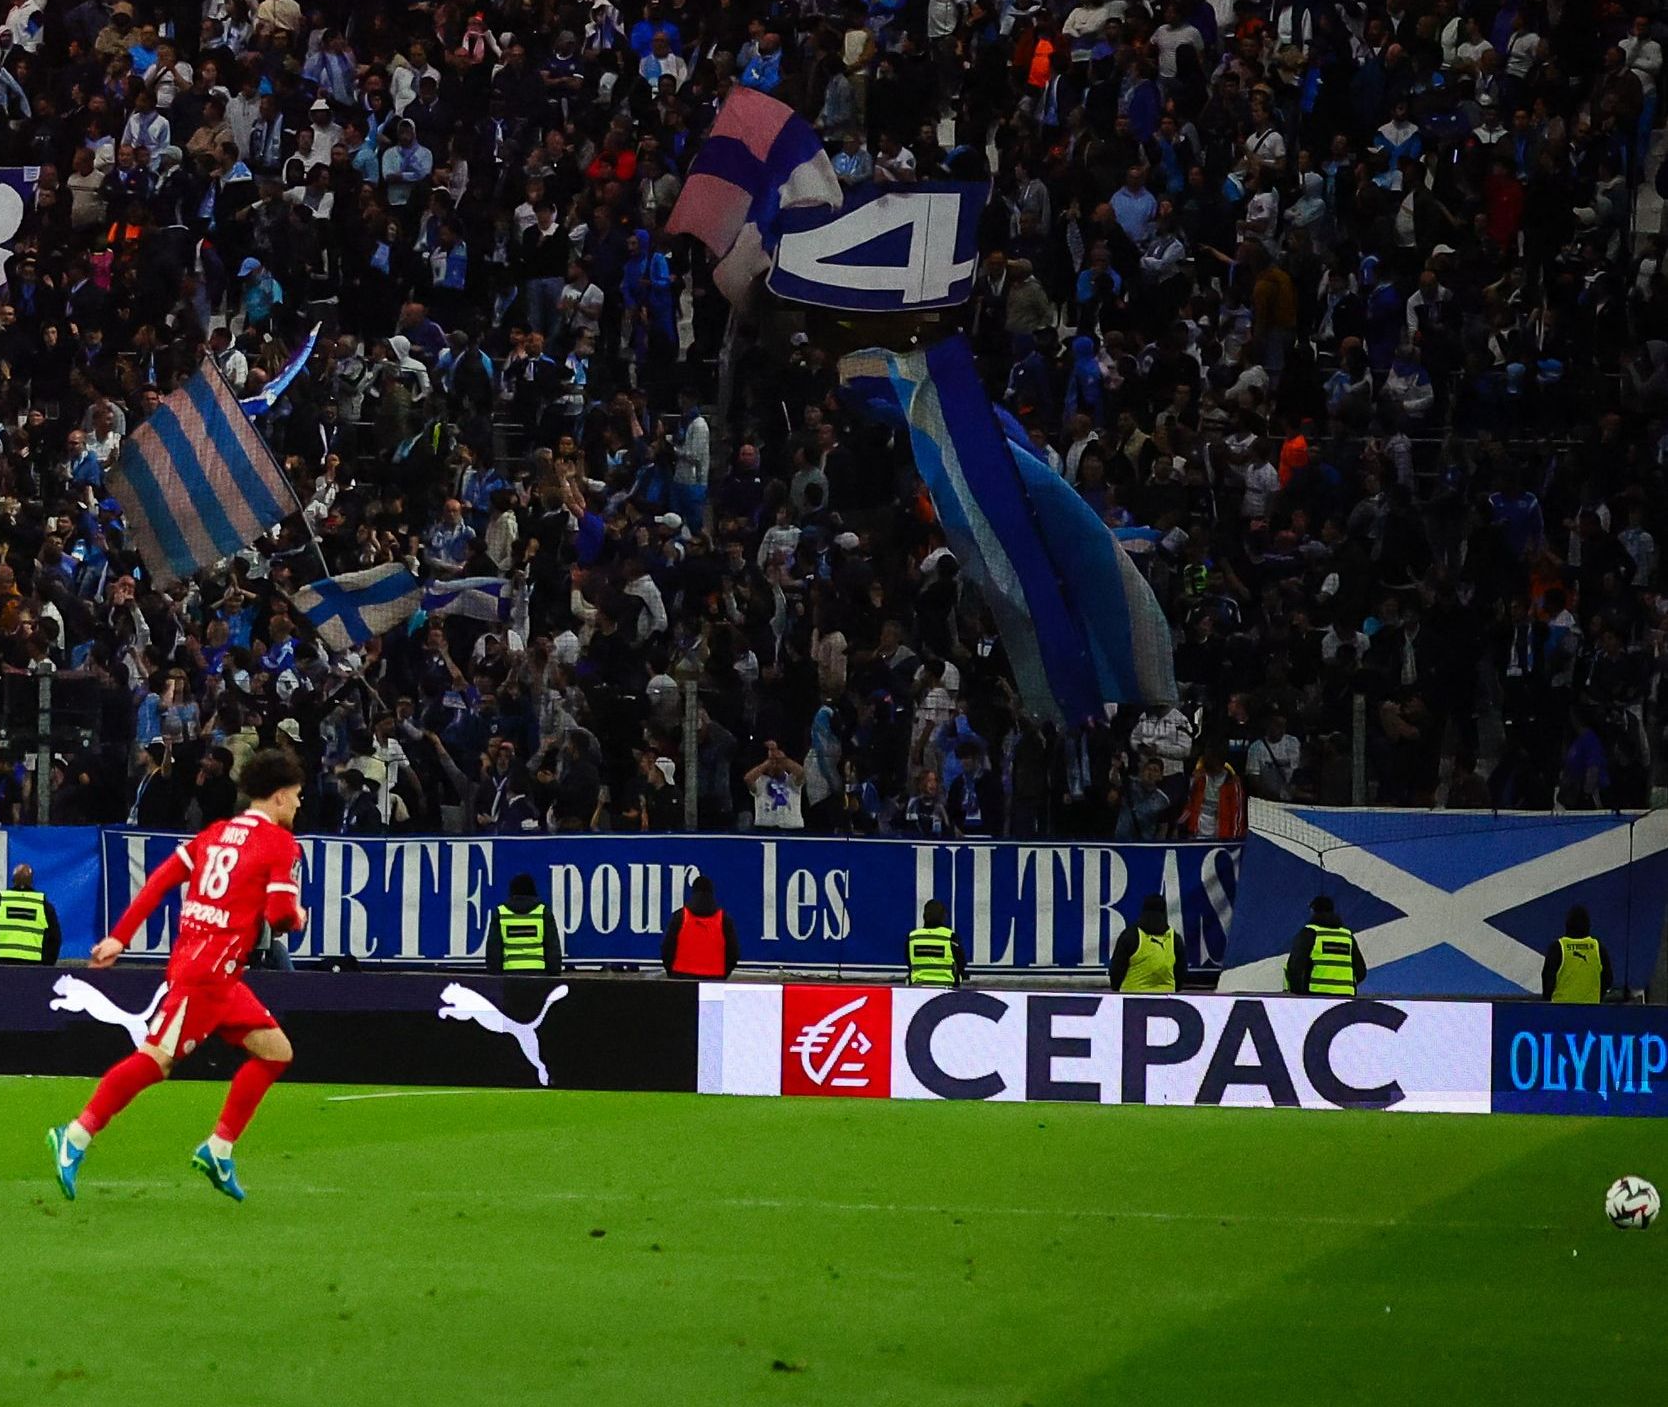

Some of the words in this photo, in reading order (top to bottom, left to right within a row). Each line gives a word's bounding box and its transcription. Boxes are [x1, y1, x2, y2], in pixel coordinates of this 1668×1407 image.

[777, 192, 979, 304] 4
[198, 844, 239, 900] 18
[550, 863, 701, 936] pour
[760, 841, 850, 943] les
[903, 990, 1409, 1109] CEPAC
